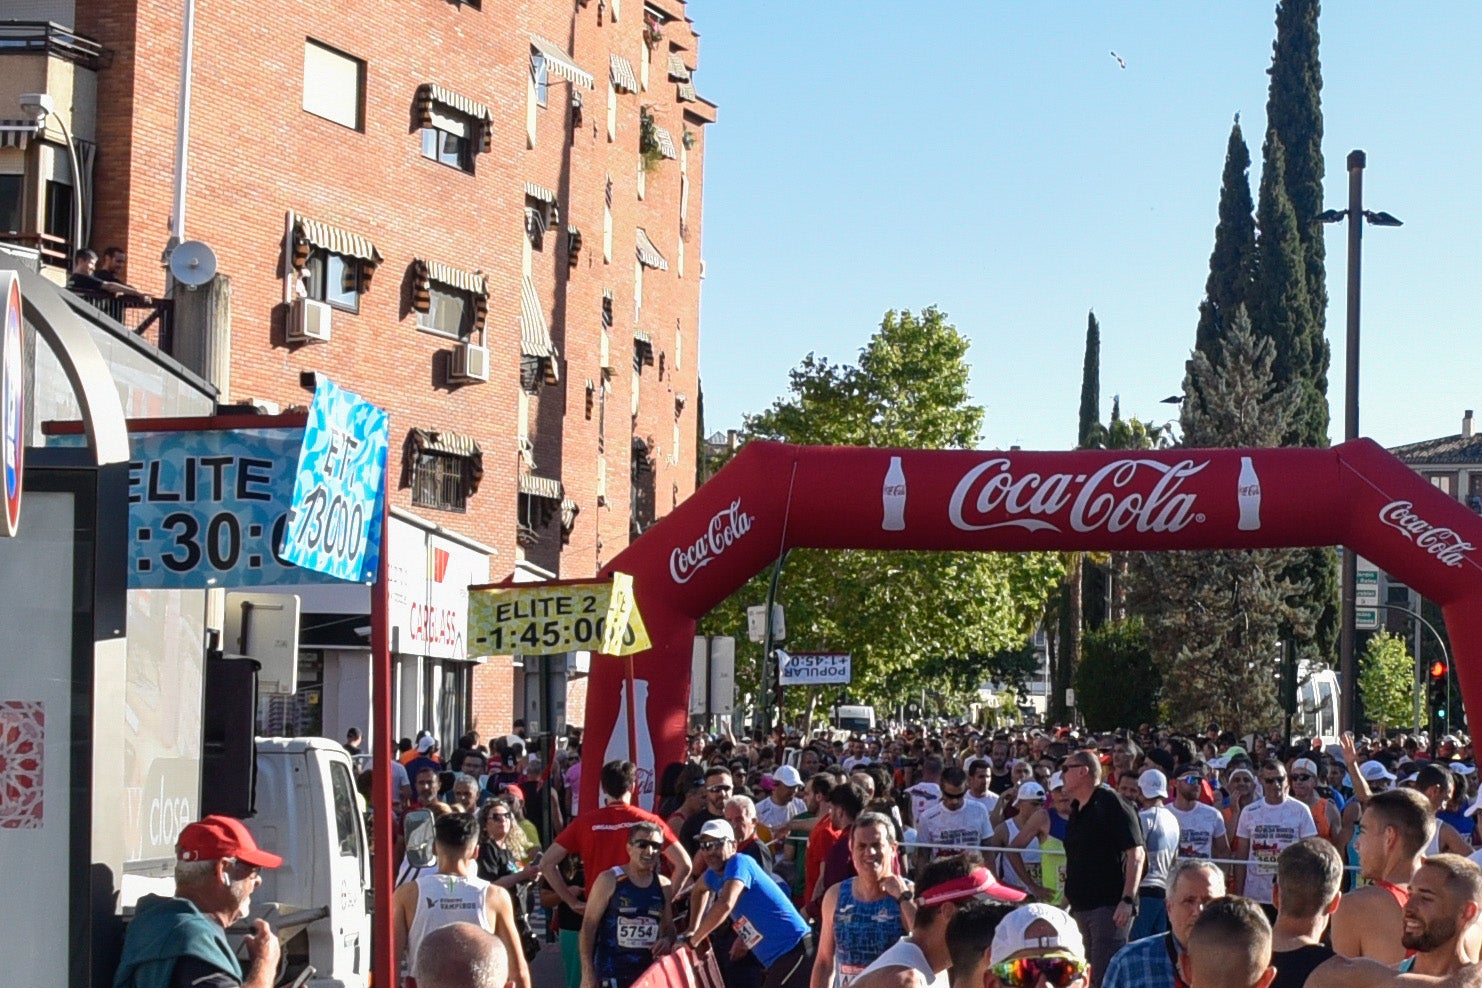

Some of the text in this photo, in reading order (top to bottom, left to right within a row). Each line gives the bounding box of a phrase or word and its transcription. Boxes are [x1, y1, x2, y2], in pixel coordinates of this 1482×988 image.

[948, 458, 1210, 533] Coca-Cola
[669, 496, 755, 584] Coca-Cola
[1379, 500, 1477, 568] Coca-Cola
[496, 596, 572, 622] ELITE
[582, 595, 597, 613] 2
[784, 666, 847, 678] POPULAR
[620, 925, 654, 939] 5754
